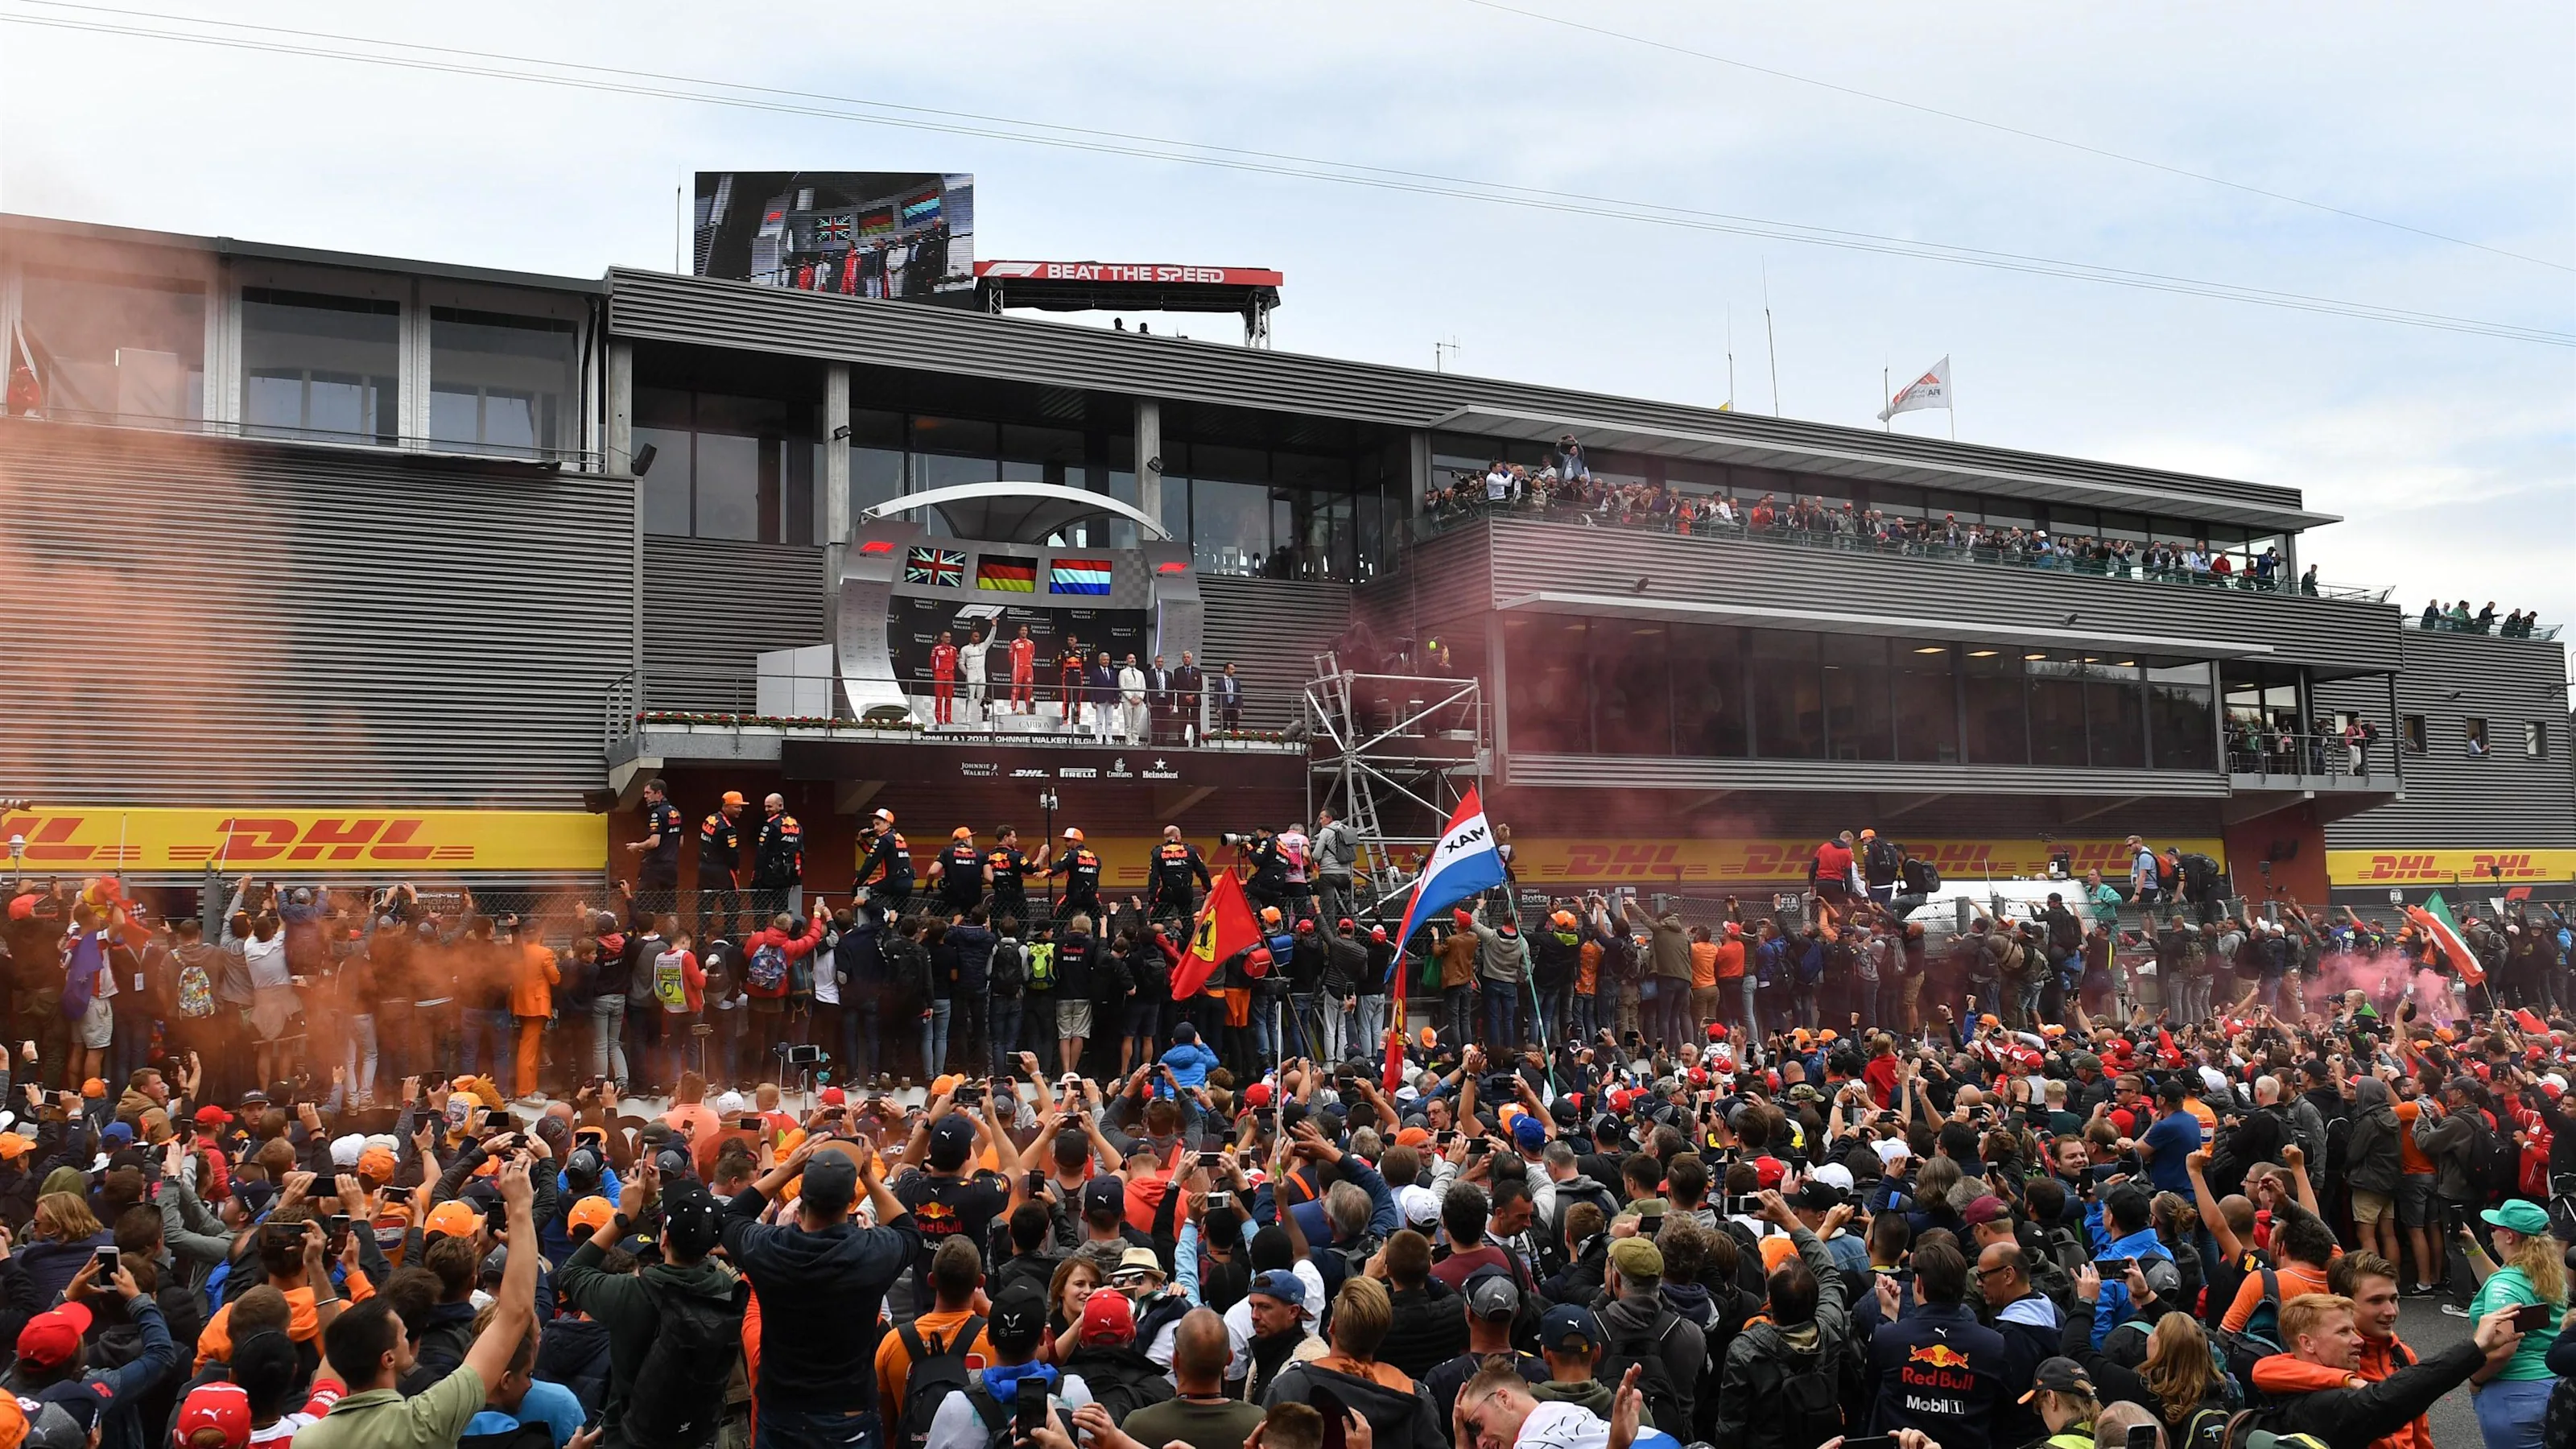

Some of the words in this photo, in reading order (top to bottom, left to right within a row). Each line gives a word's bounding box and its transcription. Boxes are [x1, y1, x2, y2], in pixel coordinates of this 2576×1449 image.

[1047, 264, 1100, 279] BEAT
[1108, 266, 1152, 281] THE
[1156, 268, 1224, 283] SPEED
[991, 735, 1030, 743] OHNNIE
[1031, 736, 1068, 744] WALKER
[960, 762, 990, 770] JOHNNIE
[963, 769, 990, 777] WALKER
[1014, 769, 1045, 777] DHL
[1059, 767, 1097, 778] PIRELLI
[1106, 770, 1133, 778] Emirates
[1142, 770, 1179, 779] Heineken
[213, 819, 436, 860] DHL
[1565, 845, 1686, 875] DHL
[2372, 855, 2441, 878] DHL
[2472, 855, 2535, 877] DHL
[2390, 891, 2402, 902] FIA
[2343, 931, 2355, 939] 46
[936, 1220, 962, 1233] Bull
[1902, 1366, 1938, 1385] Red
[1939, 1371, 1975, 1391] Bull
[1906, 1394, 1949, 1413] Mobil
